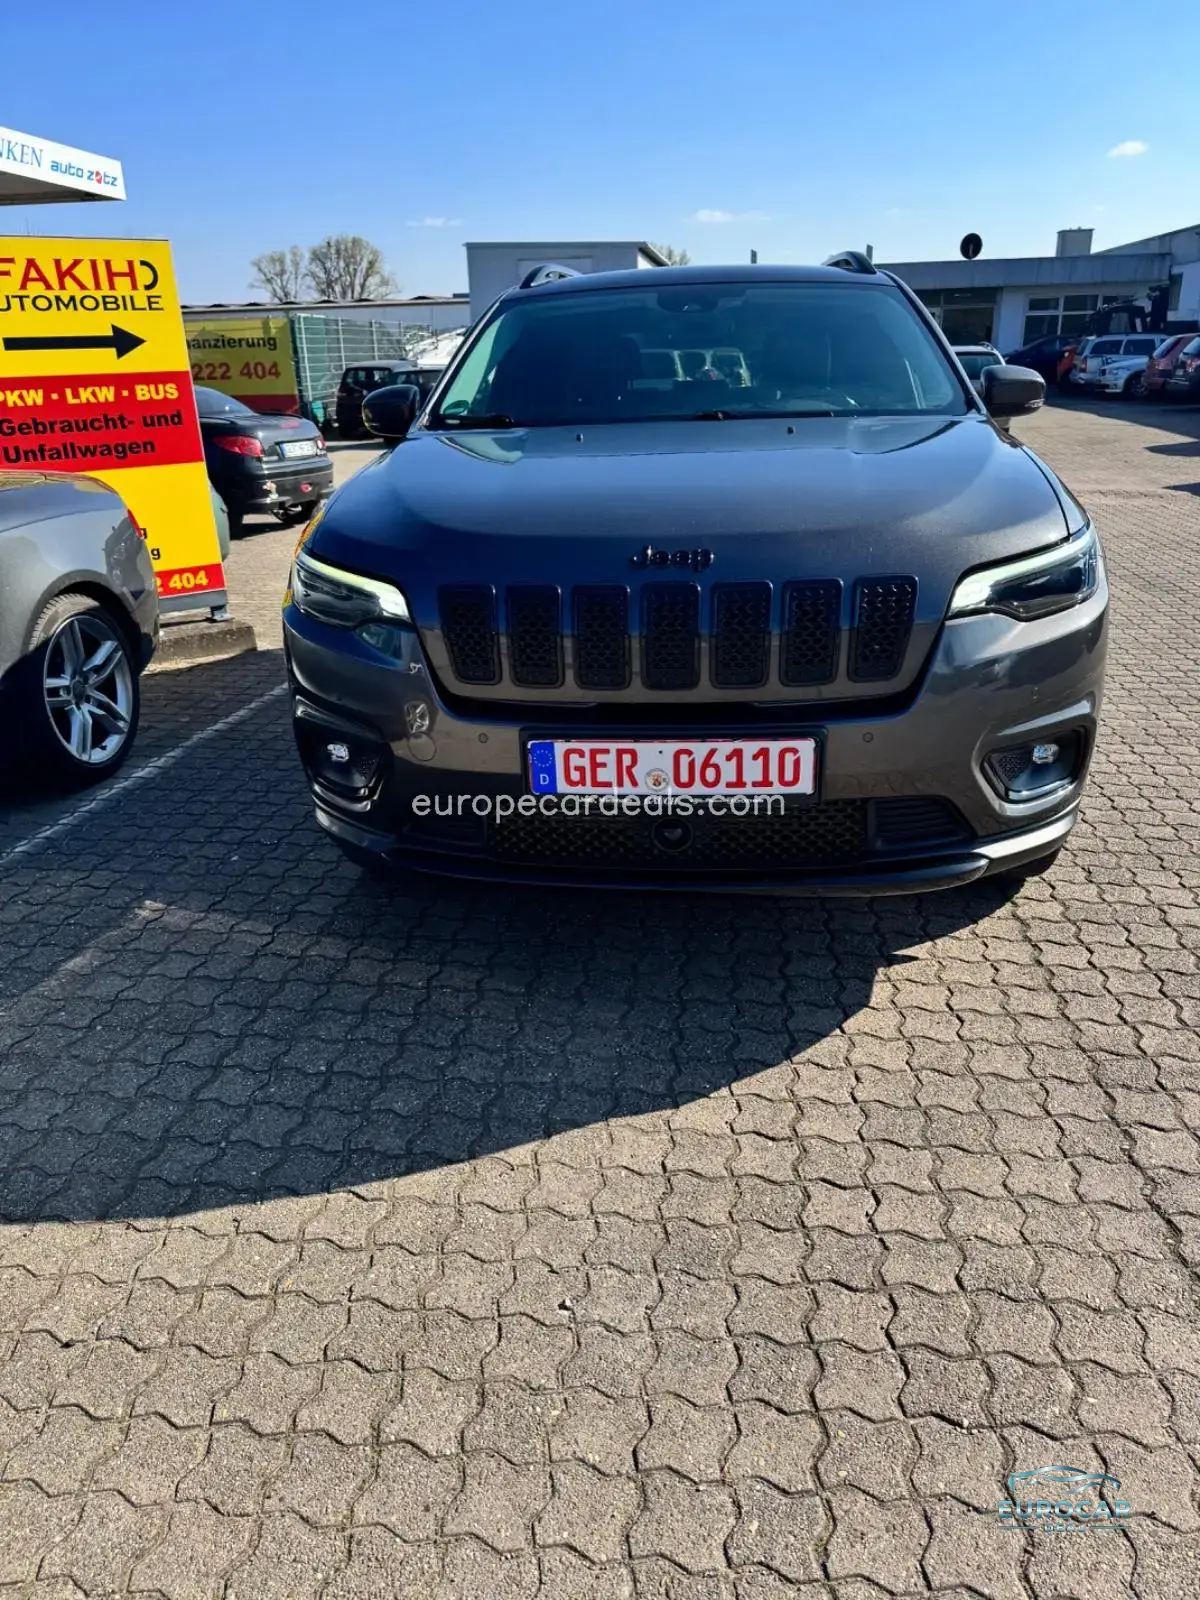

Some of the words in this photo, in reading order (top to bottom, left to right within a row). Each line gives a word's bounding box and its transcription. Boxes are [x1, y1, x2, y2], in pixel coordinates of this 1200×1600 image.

[0, 138, 43, 168] KEN
[51, 159, 83, 178] auto
[240, 361, 281, 379] 404
[65, 385, 115, 405] LKW
[135, 383, 179, 401] BUS
[0, 412, 135, 436] Gebraucht-
[142, 410, 183, 428] und
[4, 438, 156, 463] Unfallwagen
[628, 545, 715, 573] Jeep
[168, 570, 208, 589] 404
[562, 748, 639, 788] GER
[672, 747, 801, 788] 06110
[539, 774, 550, 785] D
